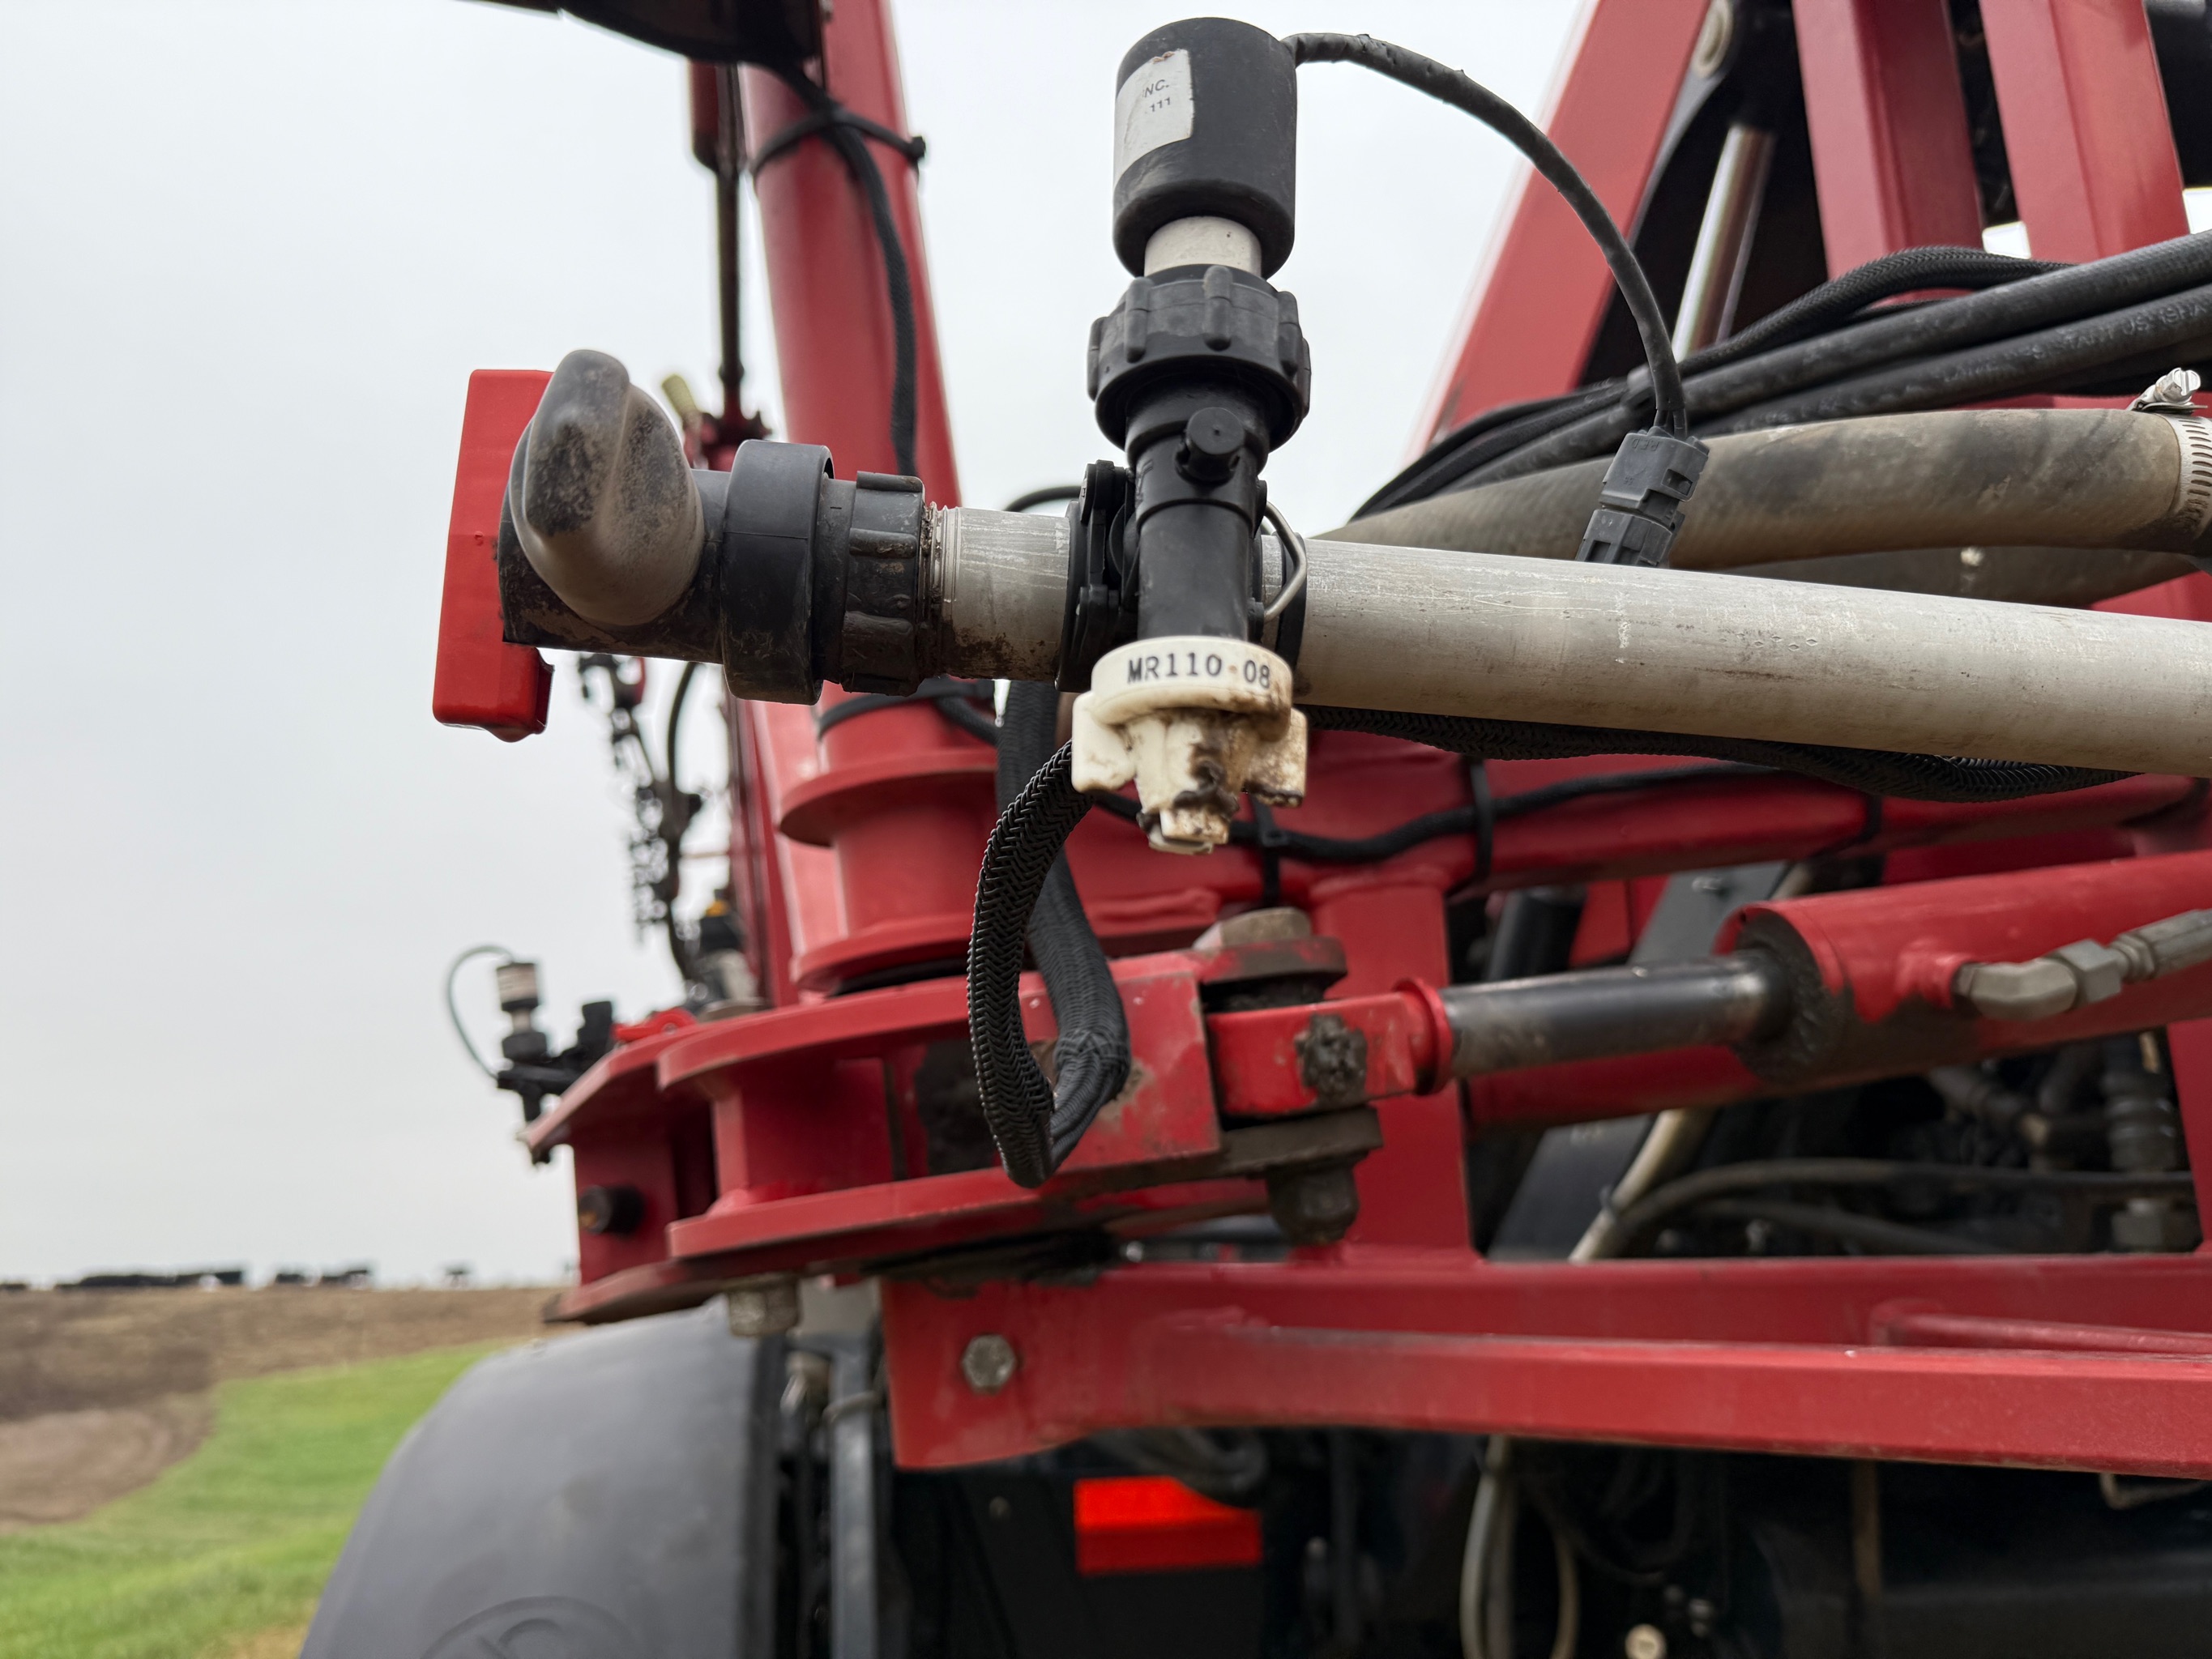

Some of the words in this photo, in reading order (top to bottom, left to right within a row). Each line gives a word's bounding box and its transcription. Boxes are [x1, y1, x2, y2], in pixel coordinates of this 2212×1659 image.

[1149, 97, 1171, 113] 111
[1128, 653, 1222, 684] MR110
[1244, 659, 1270, 689] 08
